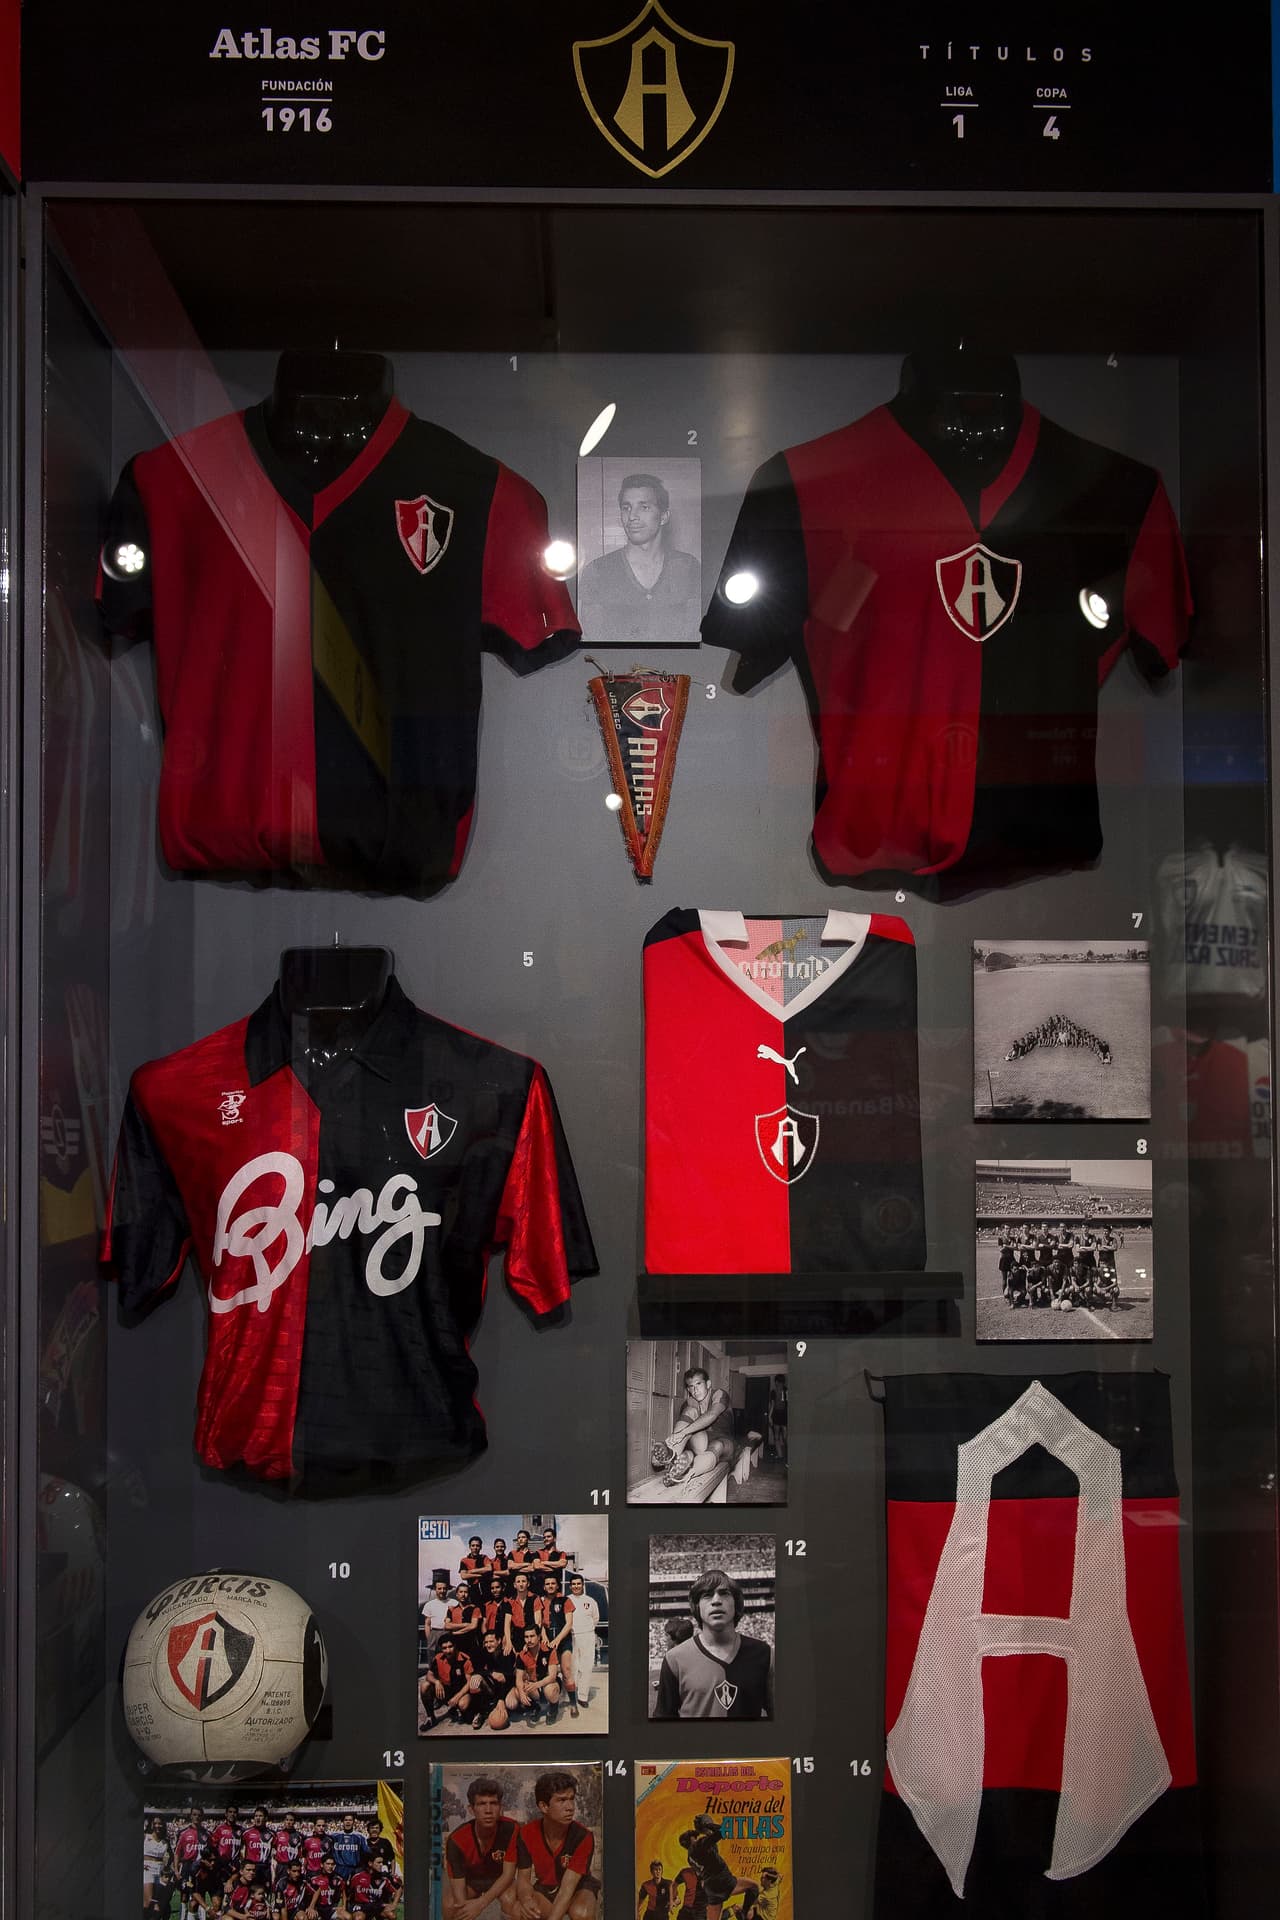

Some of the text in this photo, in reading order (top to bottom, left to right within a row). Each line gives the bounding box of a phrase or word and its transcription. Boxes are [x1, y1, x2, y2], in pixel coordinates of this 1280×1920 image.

[209, 28, 386, 61] Atlas FC
[919, 41, 1092, 62] TÍTULOS
[261, 78, 333, 91] FUNDACIÓN
[945, 86, 974, 97] LIGA
[1036, 87, 1068, 99] COPA
[261, 107, 333, 132] 1916
[952, 114, 965, 139] 1
[1043, 115, 1061, 140] 4
[508, 355, 519, 372] 1
[1106, 353, 1118, 368] 4
[687, 430, 699, 446] 2
[706, 684, 717, 700] 3
[627, 736, 659, 816] ATLAS
[895, 888, 906, 903] 6
[1131, 912, 1143, 927] 7
[523, 952, 534, 967] 5
[1136, 1138, 1147, 1154] 8
[207, 1151, 442, 1314] Bing
[795, 1341, 807, 1357] 9
[590, 1489, 610, 1506] 11
[785, 1539, 807, 1556] 12
[328, 1562, 350, 1579] 10
[383, 1751, 405, 1768] 13
[604, 1759, 627, 1777] 14
[792, 1756, 815, 1774] 15
[849, 1759, 872, 1777] 16
[676, 1776, 784, 1795] Deporte
[704, 1795, 785, 1815] Historia del
[719, 1815, 785, 1840] ATLAS
